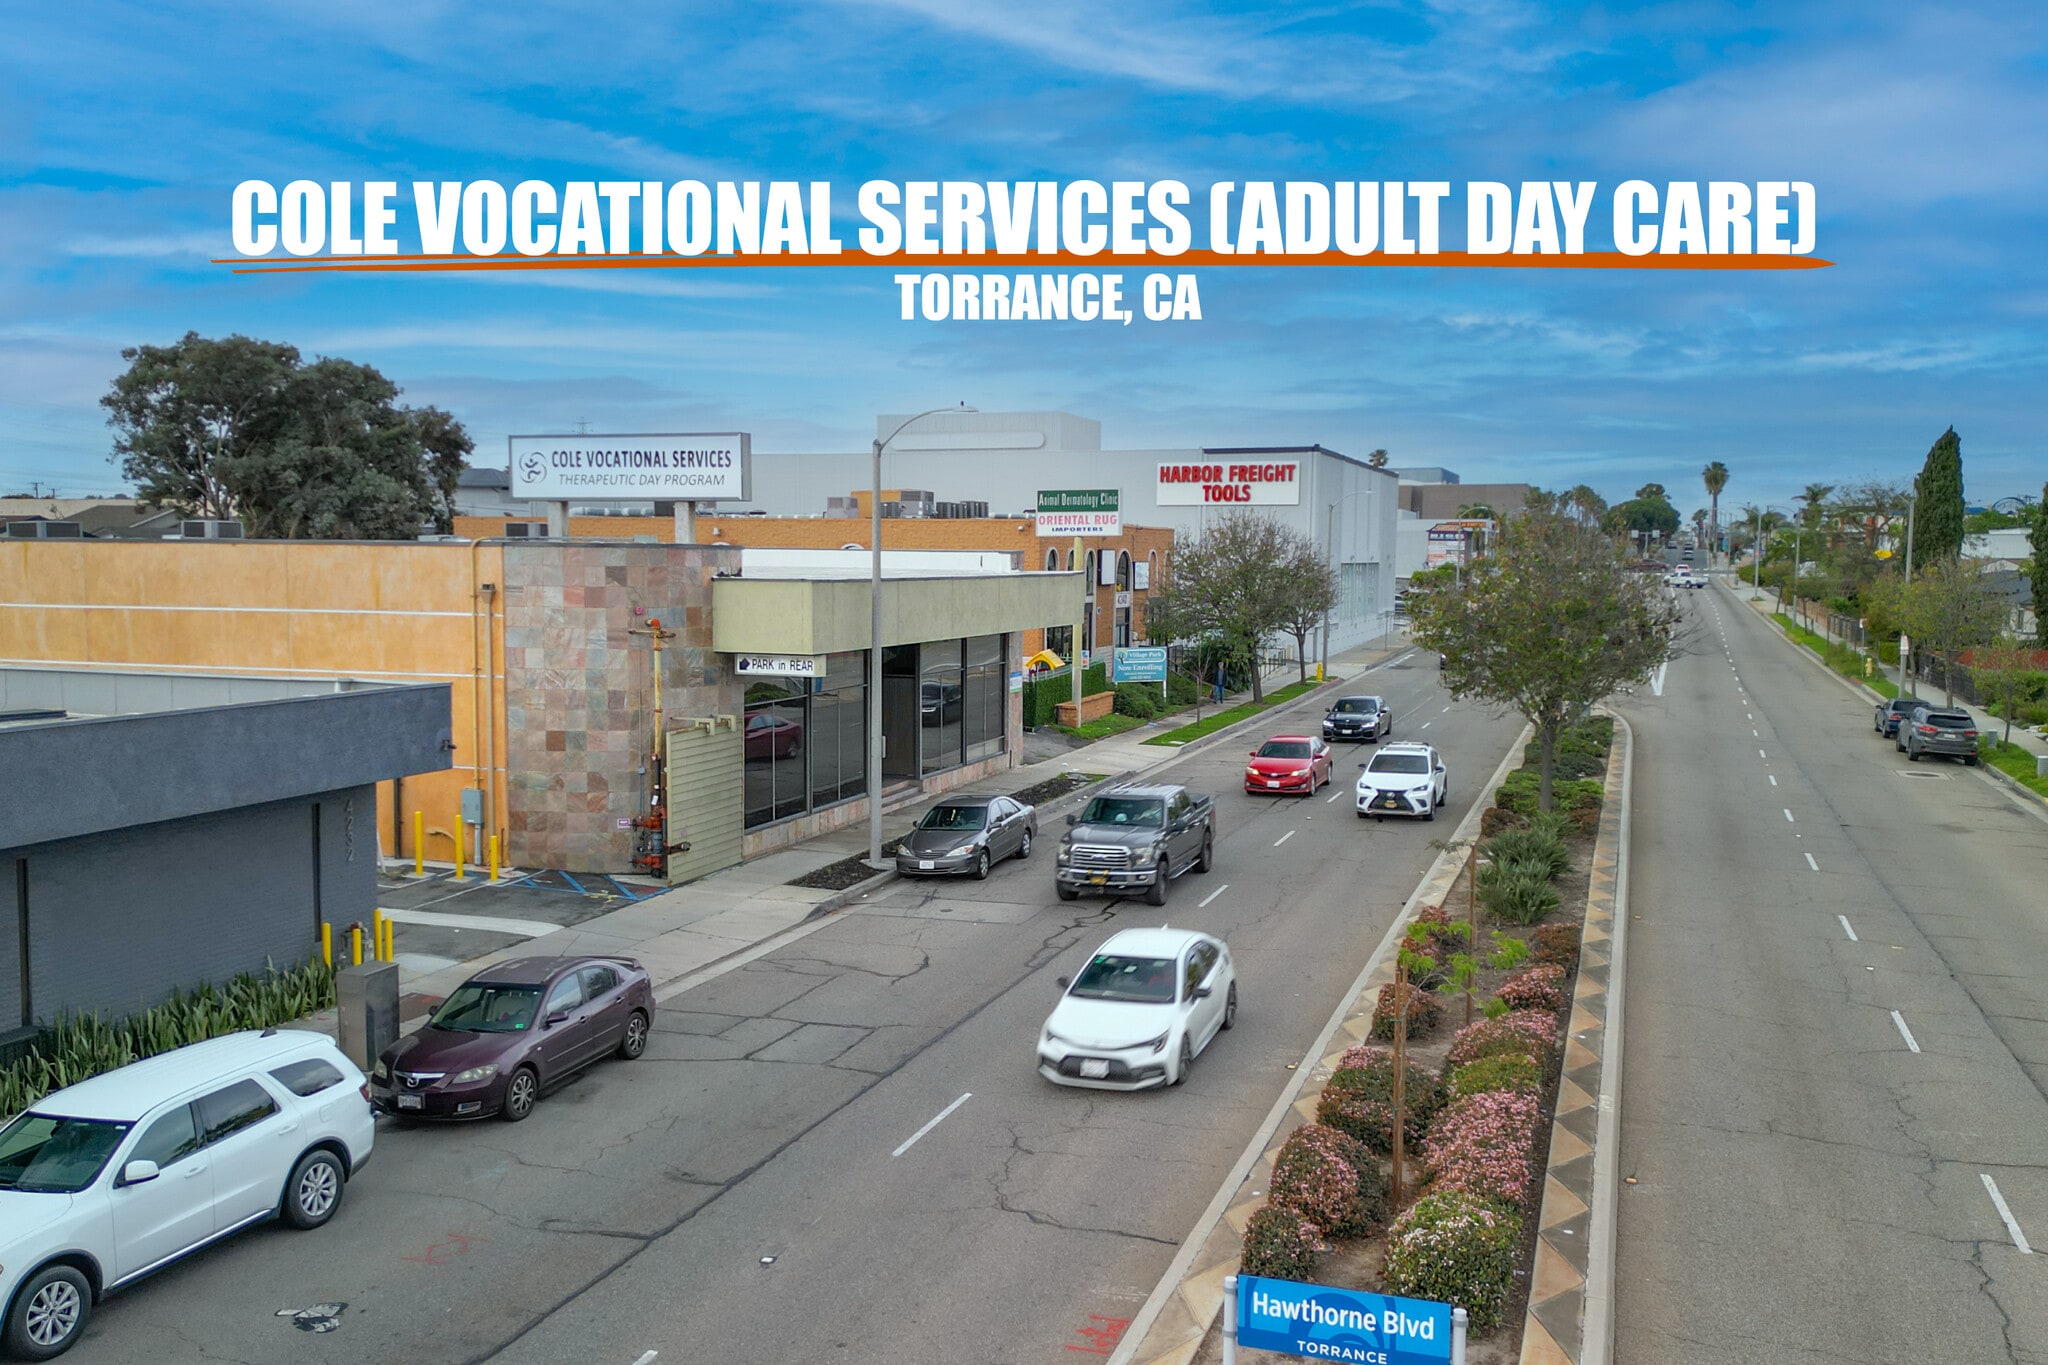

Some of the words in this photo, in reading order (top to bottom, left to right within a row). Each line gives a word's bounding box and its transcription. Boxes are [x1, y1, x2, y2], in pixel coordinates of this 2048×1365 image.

[552, 450, 582, 468] COLE
[586, 450, 668, 468] VOCATIONAL
[672, 450, 732, 468] SERVICES
[559, 474, 636, 486] THERAPEUTIC
[639, 474, 661, 486] DAY
[664, 474, 725, 486] PROGRAM
[1160, 465, 1223, 483] HARBOR
[1229, 464, 1296, 482] FREIGHT
[1039, 493, 1060, 506] Animal
[1061, 493, 1099, 508] Dermatology
[1100, 492, 1118, 506] Clinic
[1202, 484, 1251, 502] TOOLS
[1039, 514, 1091, 525] ORIENTAL
[1094, 514, 1118, 525] RUG
[752, 658, 774, 670] PARK
[778, 660, 786, 670] in
[790, 660, 814, 671] REAR
[1252, 1291, 1377, 1332] Hawthorne
[1383, 1310, 1435, 1340] Blvd
[1297, 1340, 1388, 1365] TORRANCE
